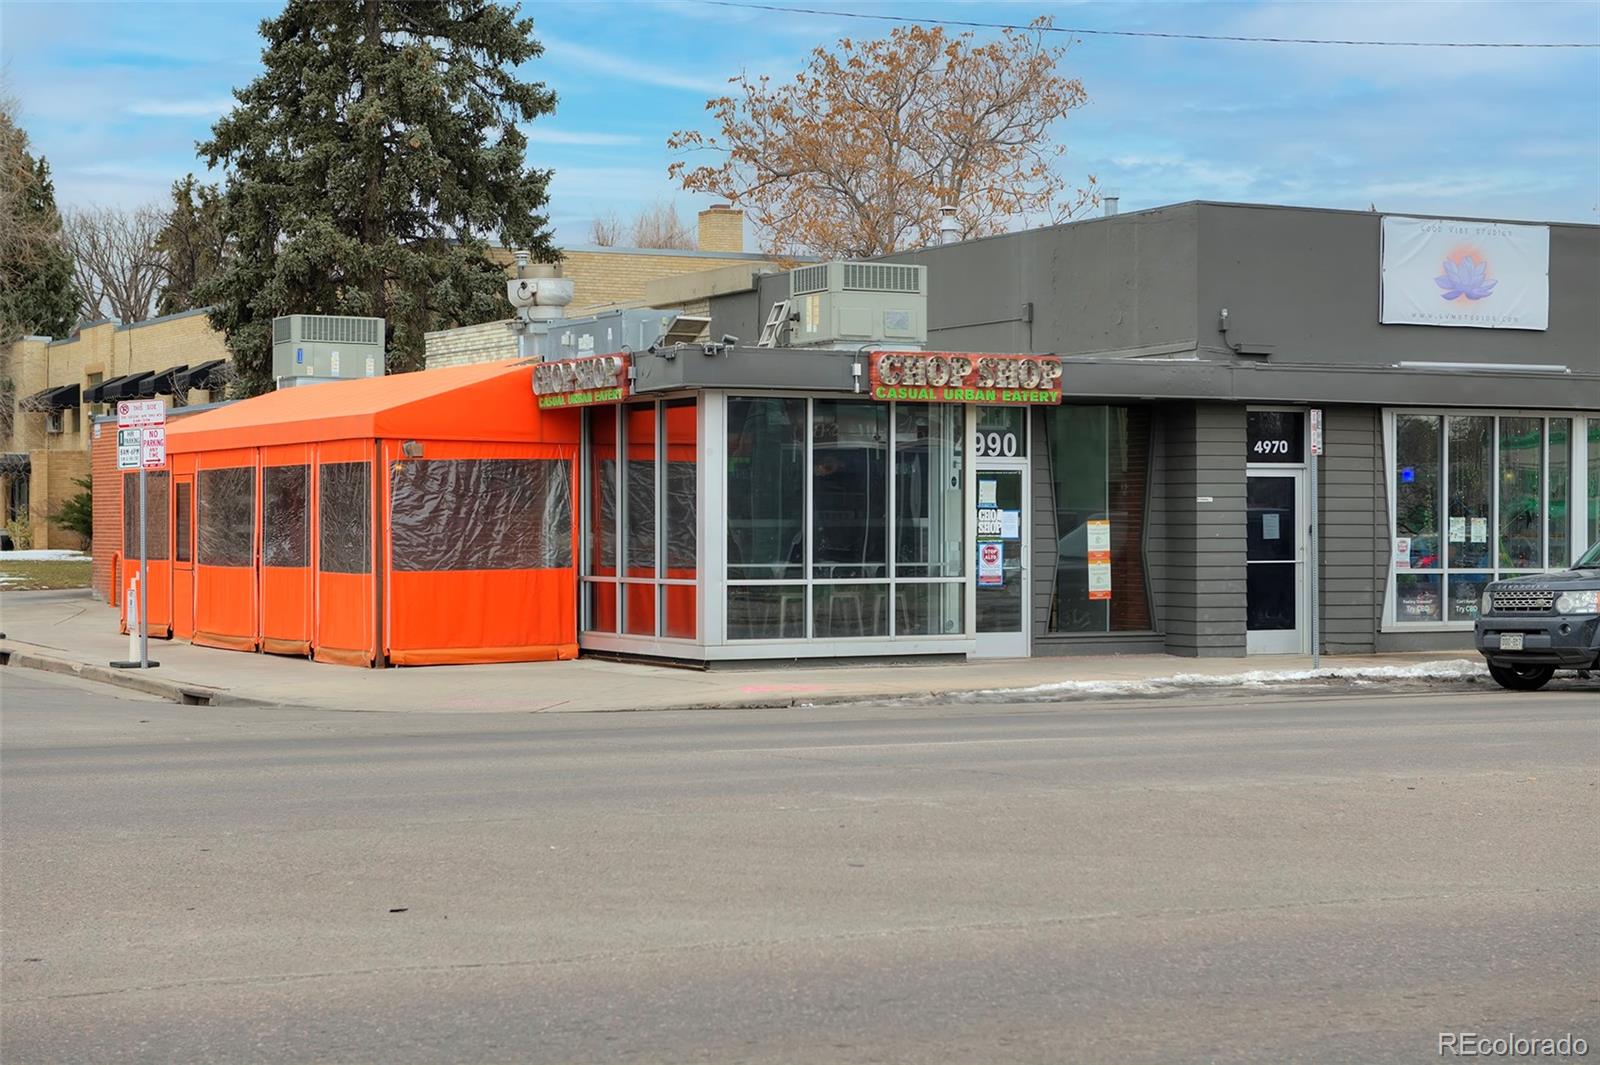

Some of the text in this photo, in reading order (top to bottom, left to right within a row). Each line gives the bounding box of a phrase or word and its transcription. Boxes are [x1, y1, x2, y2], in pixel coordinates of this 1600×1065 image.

[532, 356, 622, 396] CHOP SHOP
[878, 354, 1063, 389] CHOP SHOP
[539, 388, 623, 408] CASUAL URBAN EATERY
[876, 388, 1060, 403] CASUAL URBAN EATERY
[148, 430, 158, 438] NO
[143, 439, 164, 447] PARKING
[1253, 440, 1288, 454] 4970
[978, 521, 1001, 534] SHOP
[1406, 605, 1416, 613] Try
[1455, 605, 1465, 613] Try
